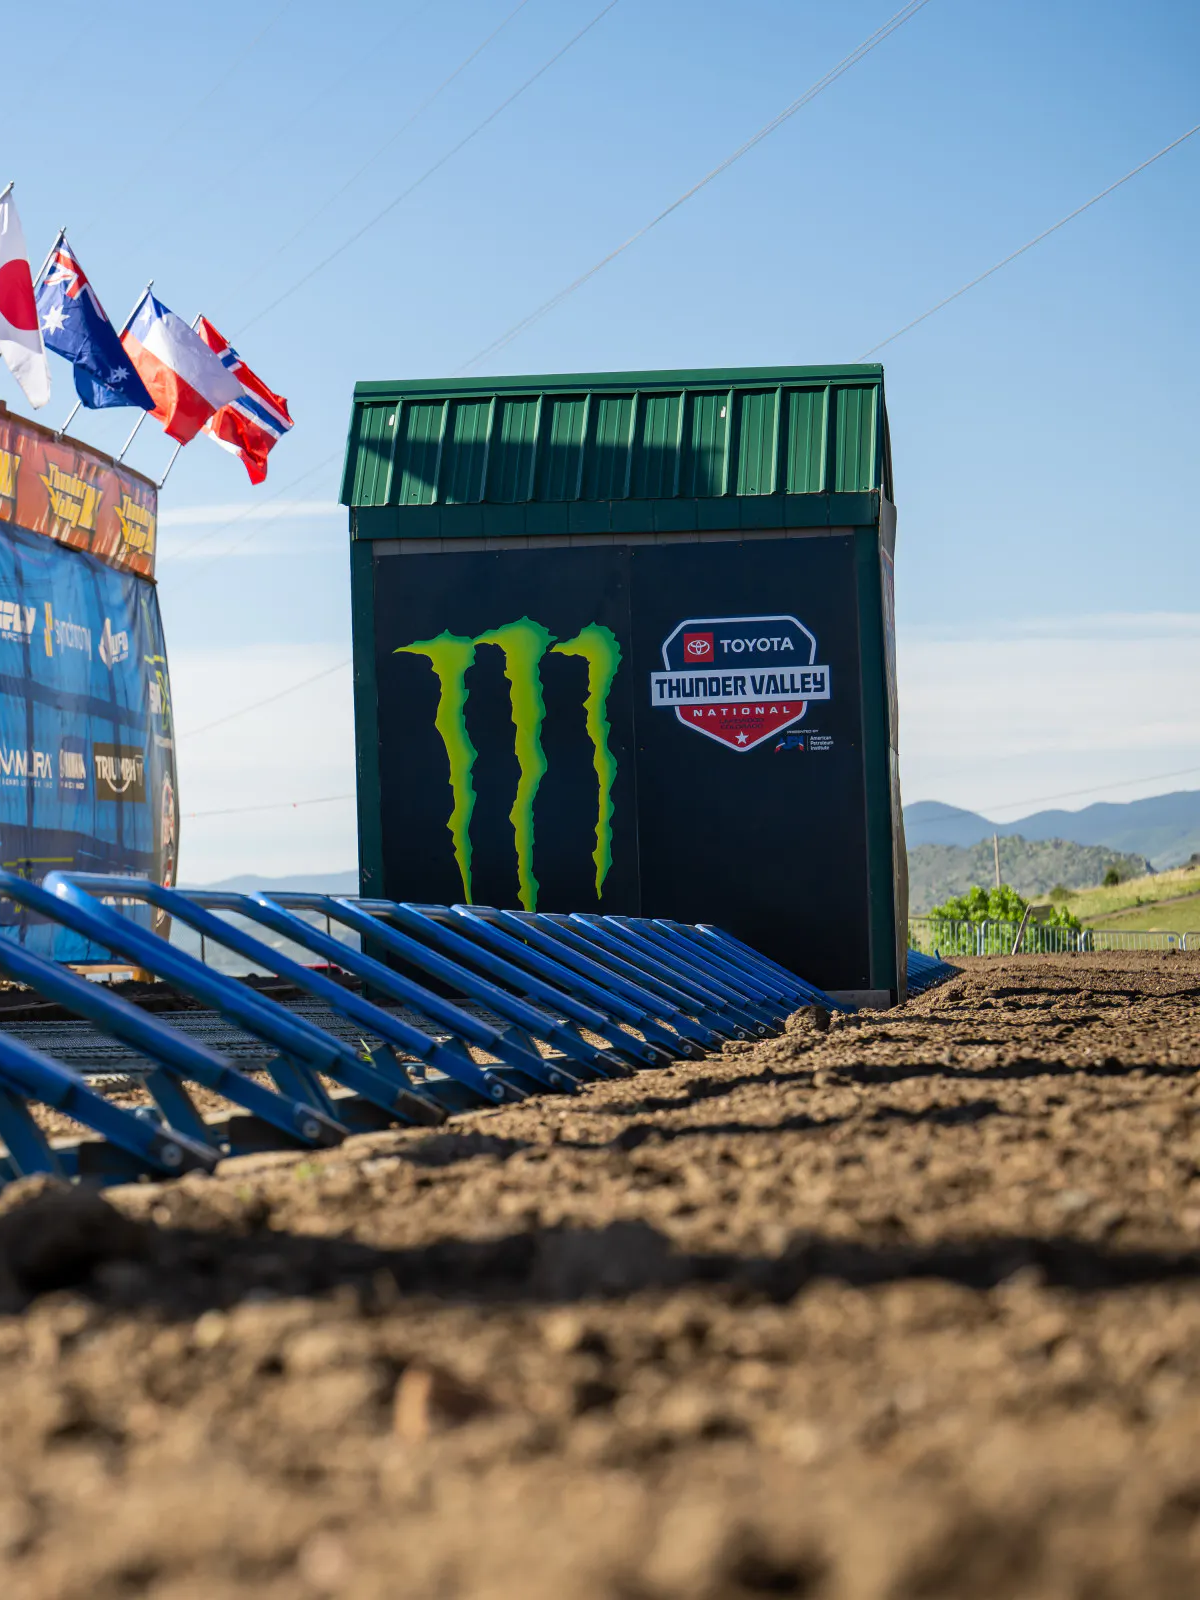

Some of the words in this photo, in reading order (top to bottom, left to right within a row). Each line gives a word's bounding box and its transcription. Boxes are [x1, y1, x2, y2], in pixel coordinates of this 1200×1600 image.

[720, 637, 795, 653] TOYOTA
[655, 675, 747, 699] THUNDER
[750, 673, 825, 695] VALLEY
[693, 705, 790, 717] NATIONAL
